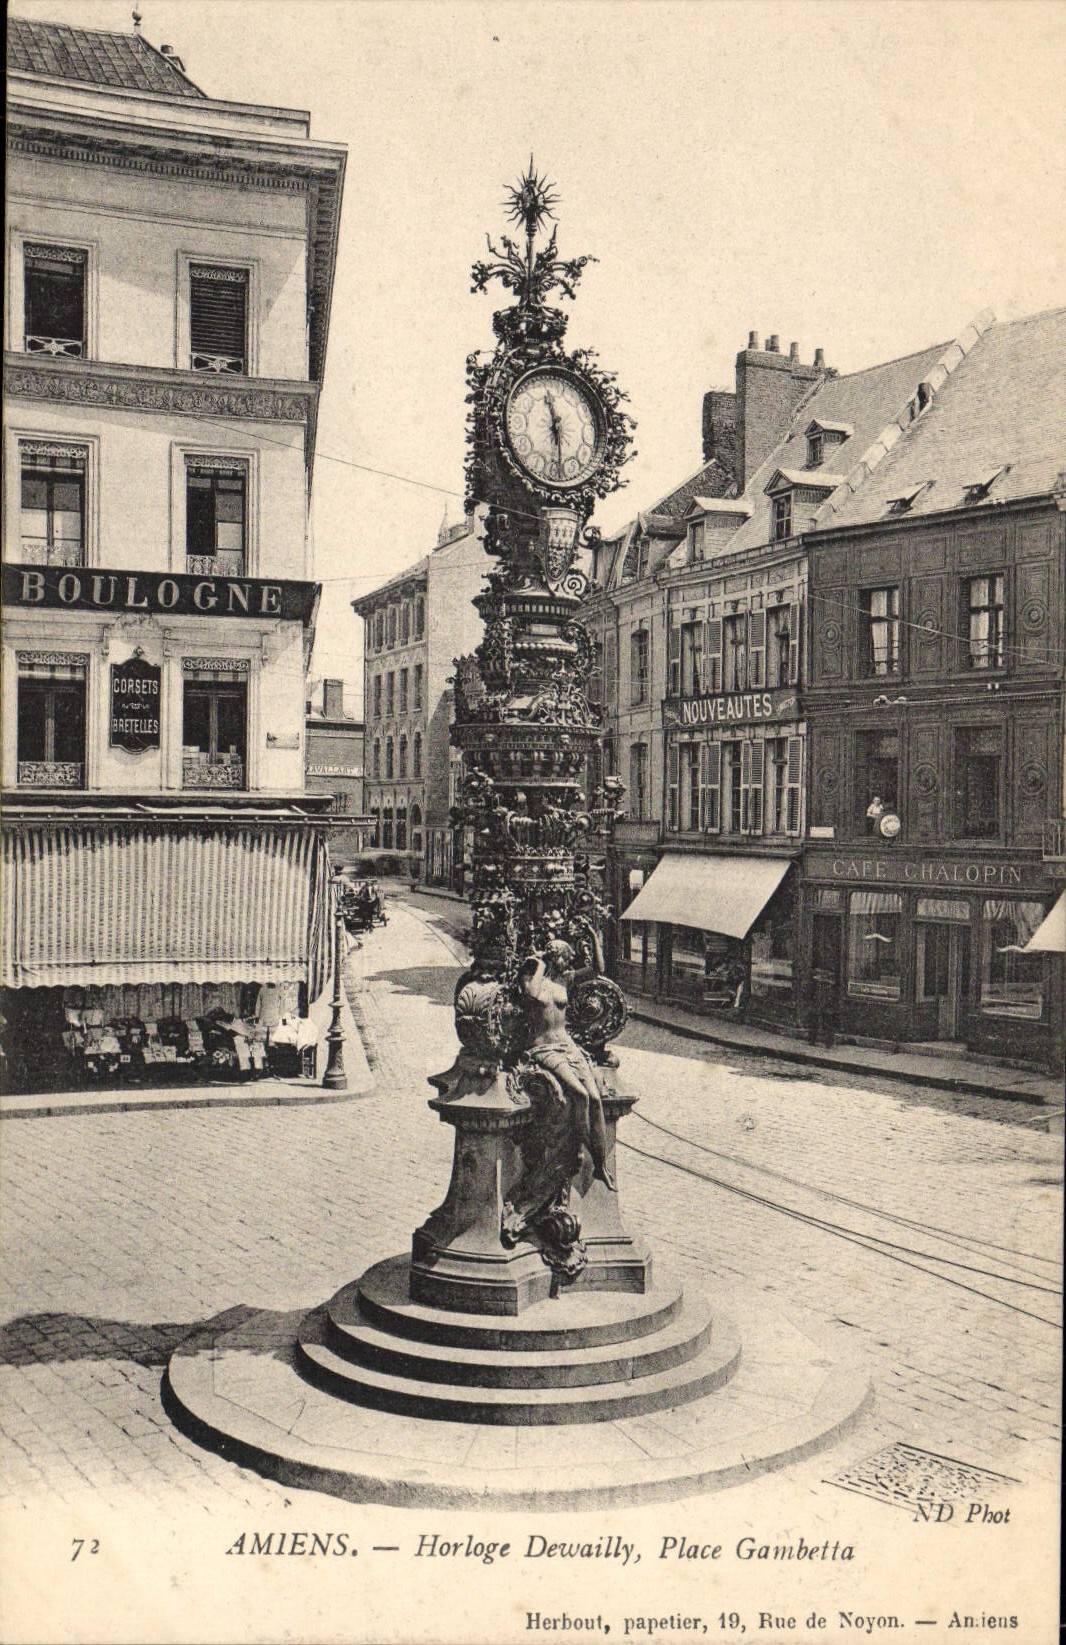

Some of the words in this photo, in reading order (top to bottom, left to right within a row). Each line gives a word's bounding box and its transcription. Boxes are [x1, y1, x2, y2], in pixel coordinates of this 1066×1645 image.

[20, 571, 283, 614] BOULOGNE
[112, 678, 159, 695] CORSETS
[682, 692, 773, 723] NOUVEAUTES
[112, 718, 159, 734] BRETELLES
[904, 862, 1022, 884] CHALOPIN
